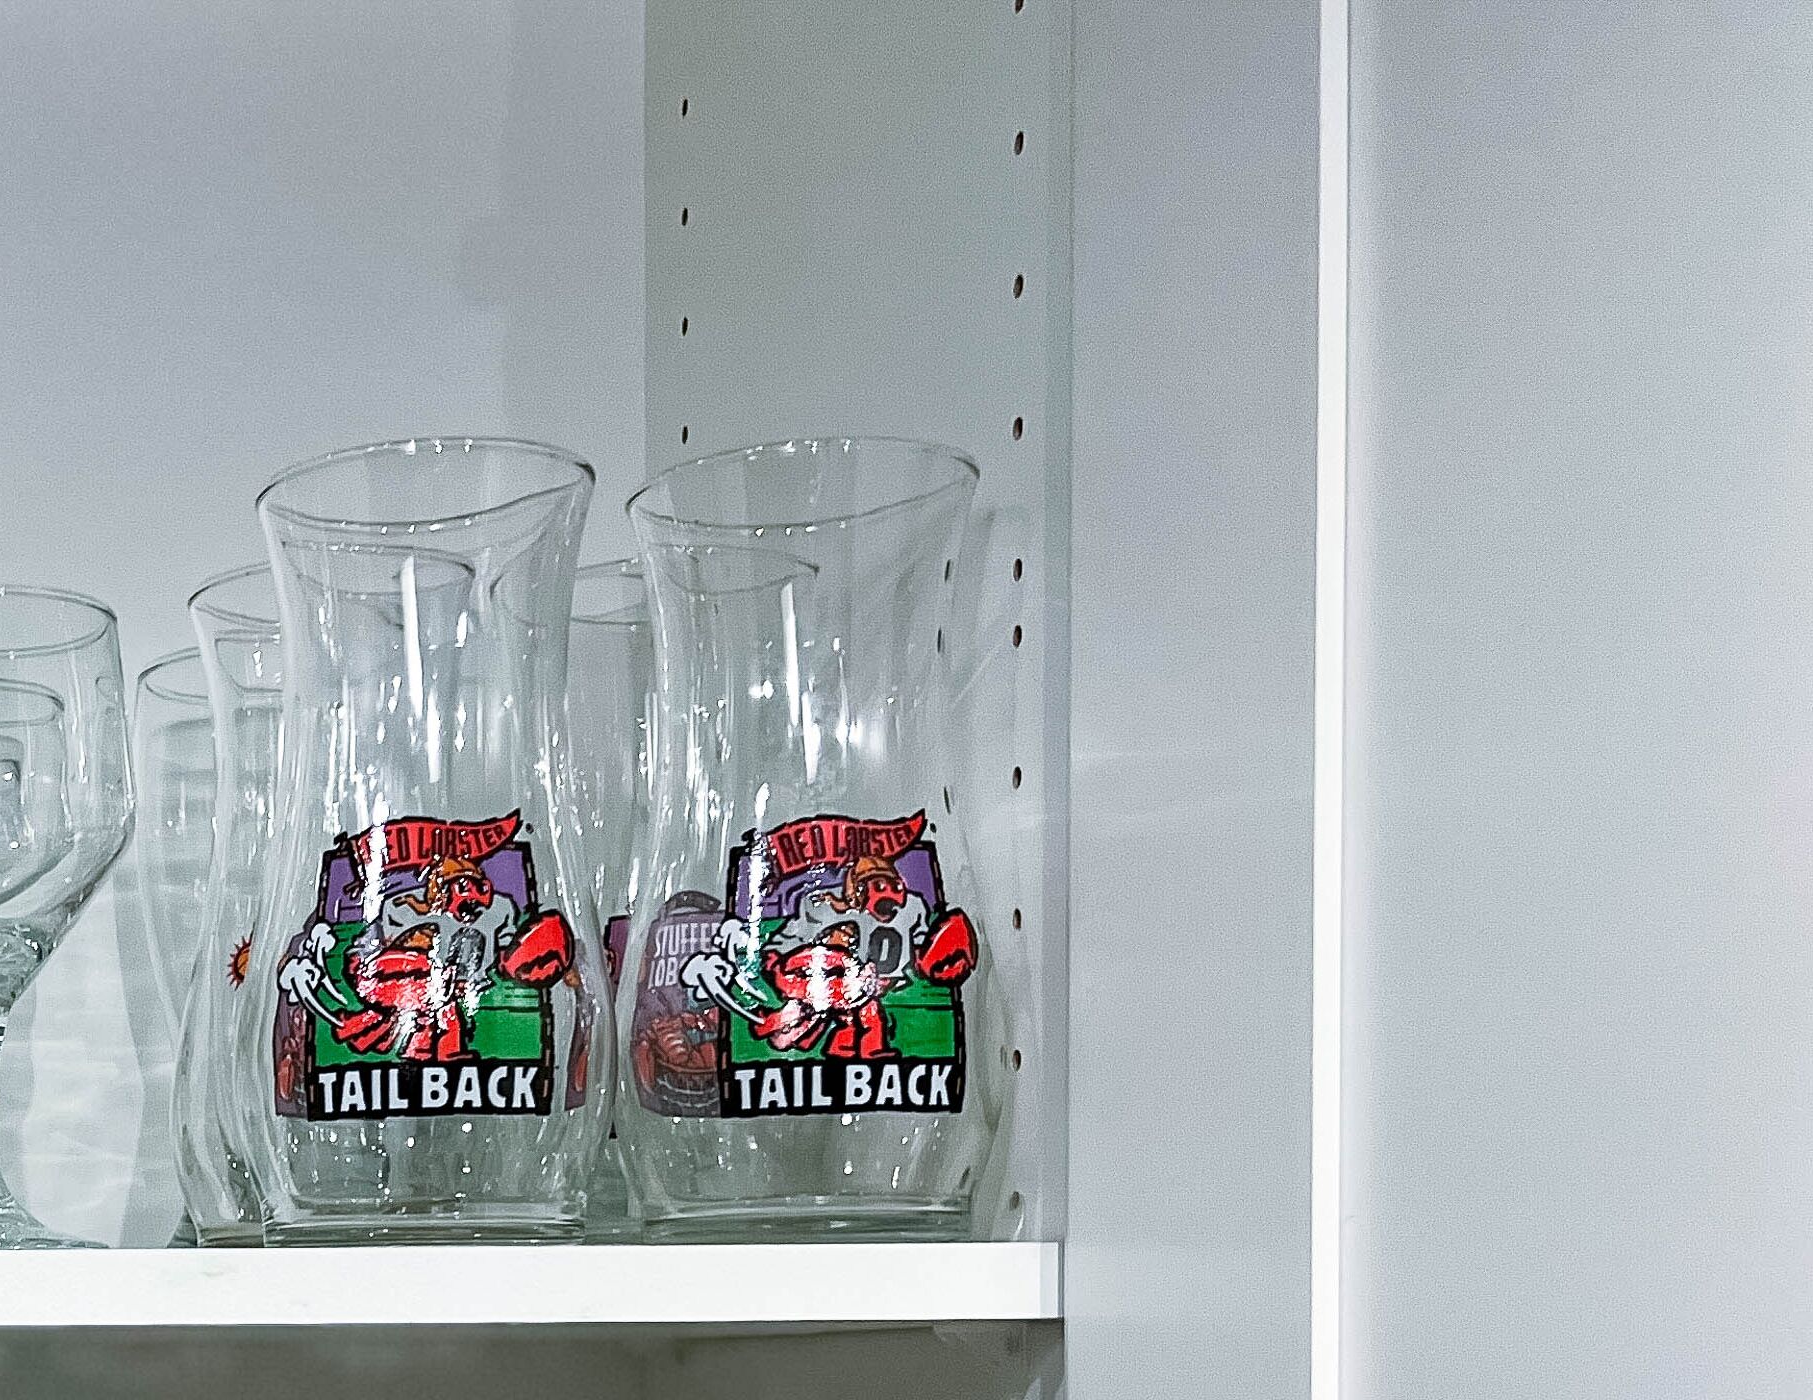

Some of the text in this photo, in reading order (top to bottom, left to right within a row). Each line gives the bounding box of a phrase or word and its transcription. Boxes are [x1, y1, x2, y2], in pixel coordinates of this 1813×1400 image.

[367, 824, 508, 866] ED LOBSTER
[778, 824, 827, 868] RED
[648, 956, 689, 989] LOB
[318, 1065, 539, 1113] TAIL BACK
[734, 1063, 952, 1110] TAIL BACK
